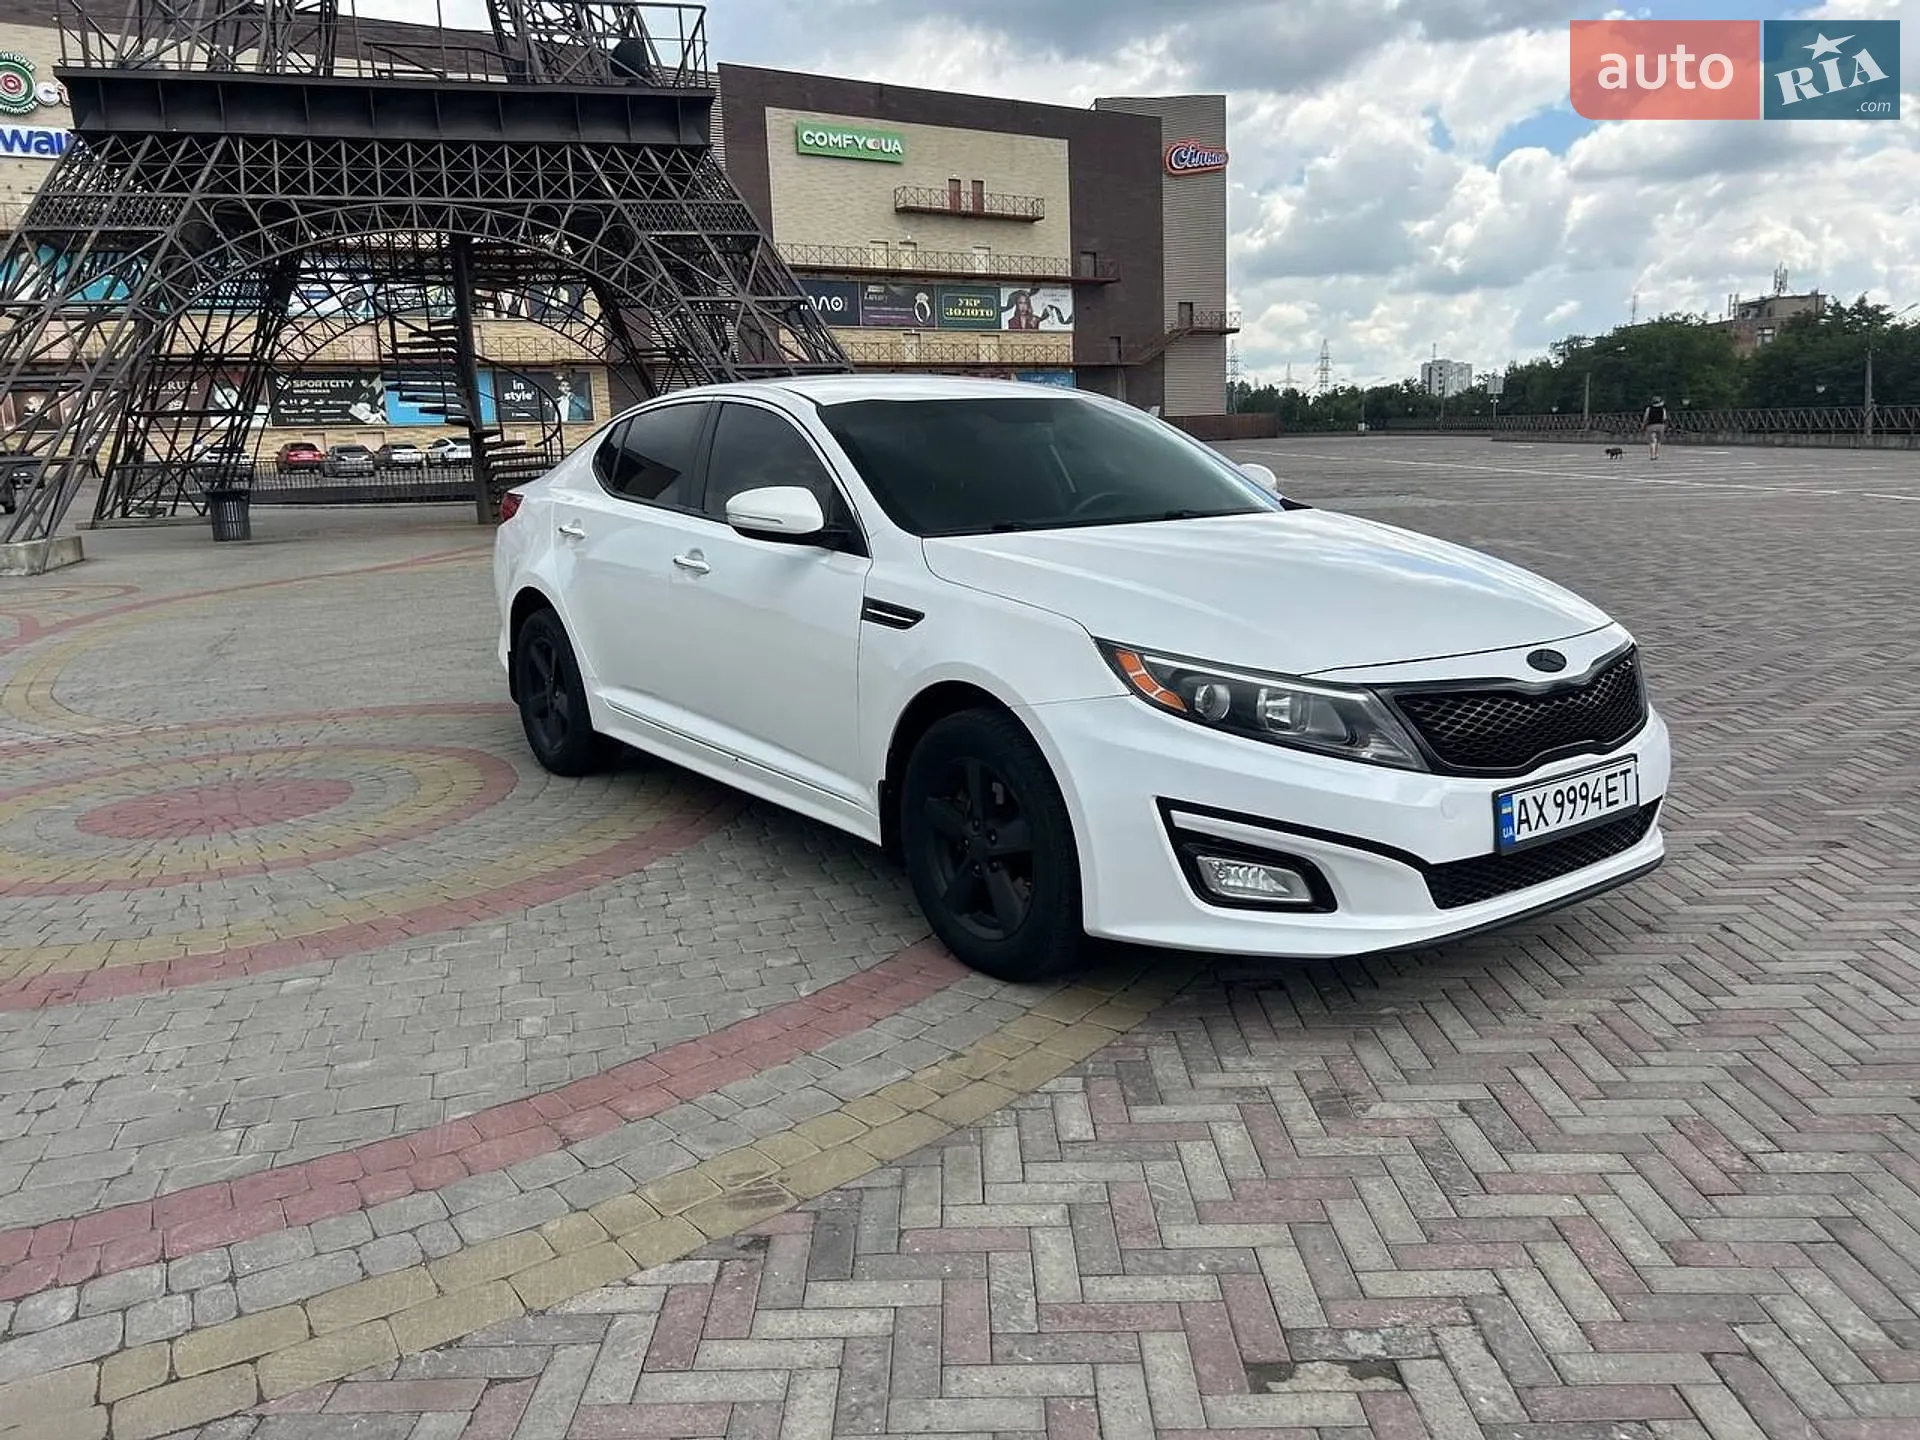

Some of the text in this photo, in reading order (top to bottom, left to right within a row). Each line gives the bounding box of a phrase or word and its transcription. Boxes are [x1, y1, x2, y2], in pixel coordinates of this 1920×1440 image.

[802, 130, 867, 150] COMFY
[957, 298, 981, 307] УКР
[945, 307, 994, 318] ЗОЛОТО
[292, 380, 354, 389] SPORTCITY
[512, 379, 525, 390] in
